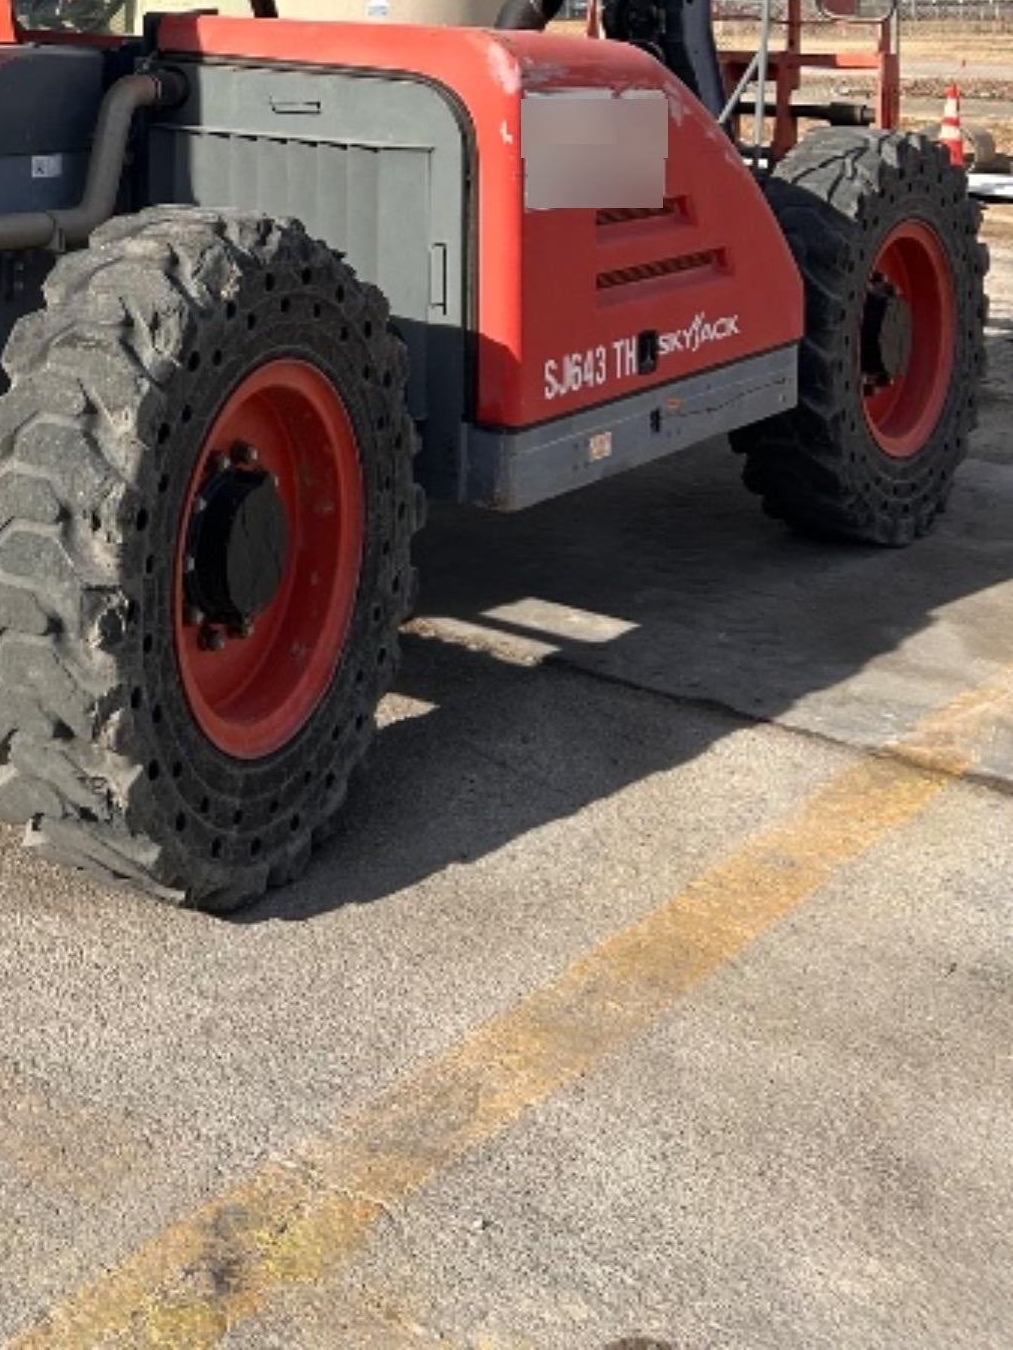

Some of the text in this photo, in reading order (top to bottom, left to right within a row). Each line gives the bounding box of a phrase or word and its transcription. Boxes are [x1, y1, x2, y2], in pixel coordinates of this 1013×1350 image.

[658, 312, 740, 355] SKYJACK
[544, 336, 637, 399] SJ643 TH
